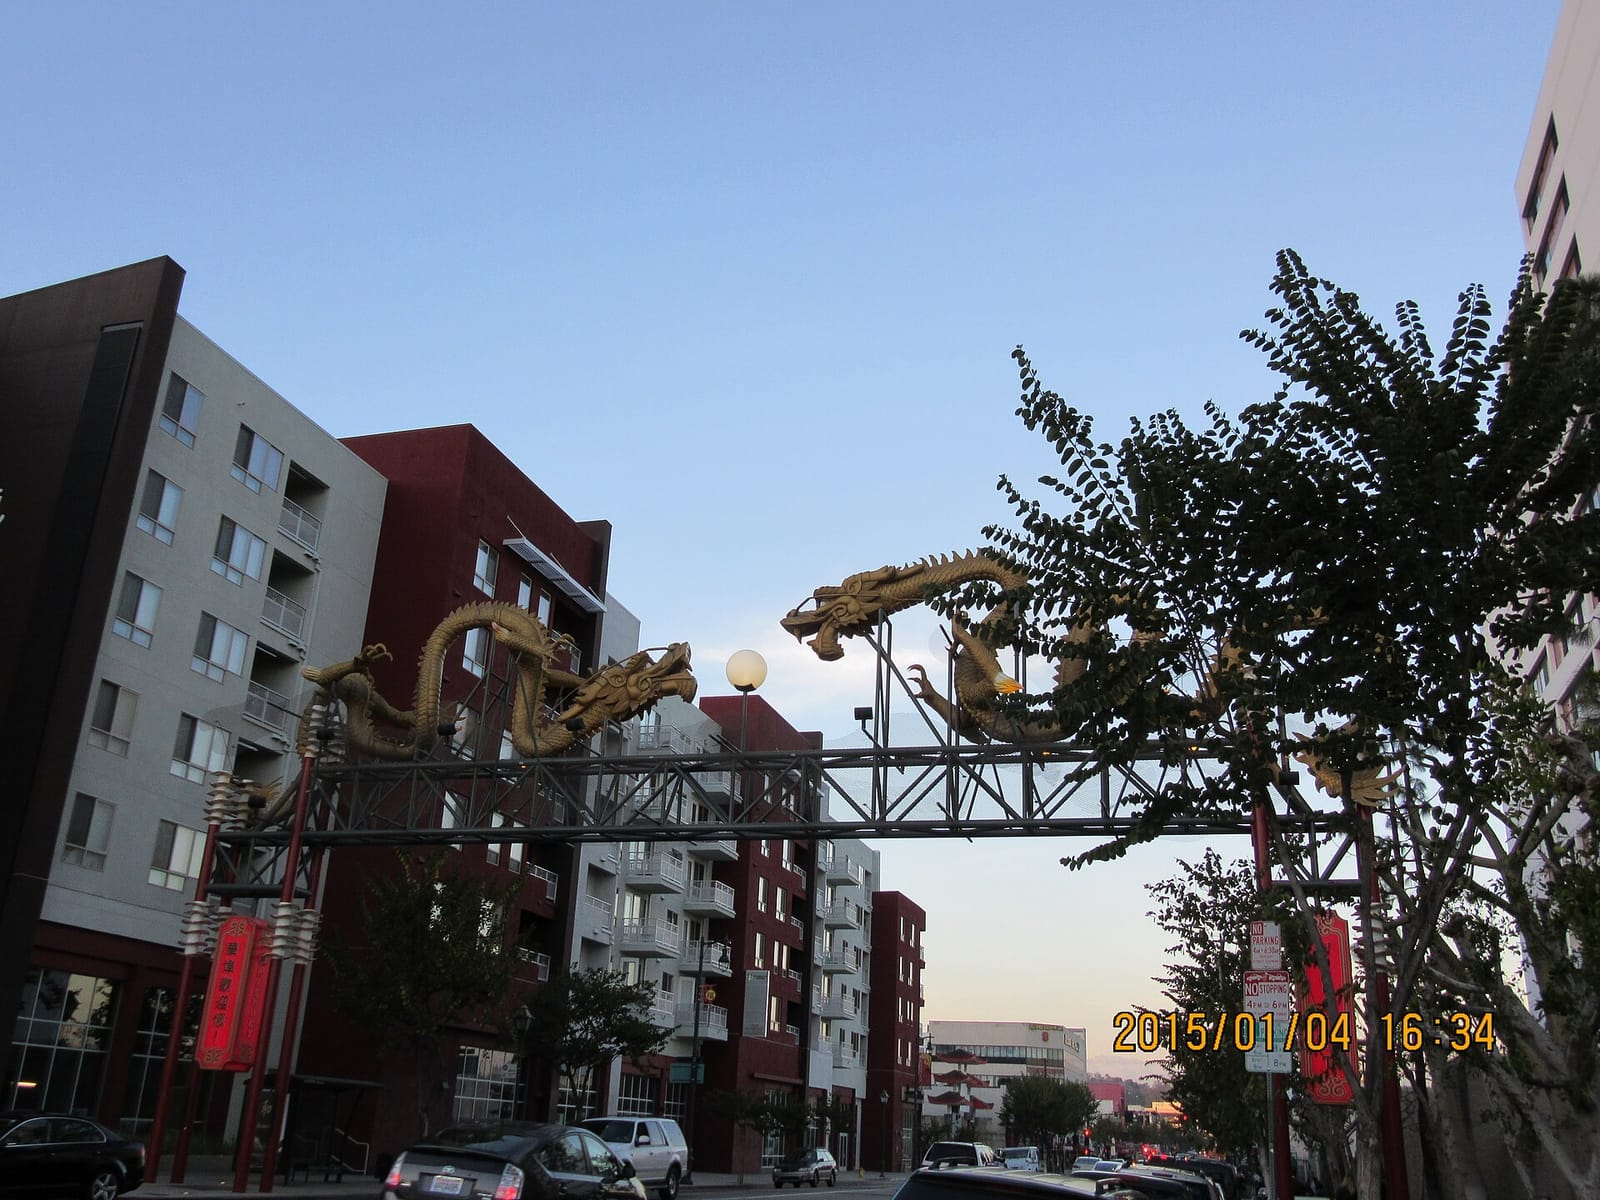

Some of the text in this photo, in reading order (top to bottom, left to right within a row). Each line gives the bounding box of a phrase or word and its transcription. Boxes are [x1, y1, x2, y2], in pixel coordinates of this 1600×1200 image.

[1252, 923, 1263, 935] NO
[1252, 936, 1279, 945] PARKING
[1245, 982, 1287, 996] NO STOPPING
[1247, 1001, 1262, 1009] 4PM
[1272, 1000, 1288, 1009] 6PM
